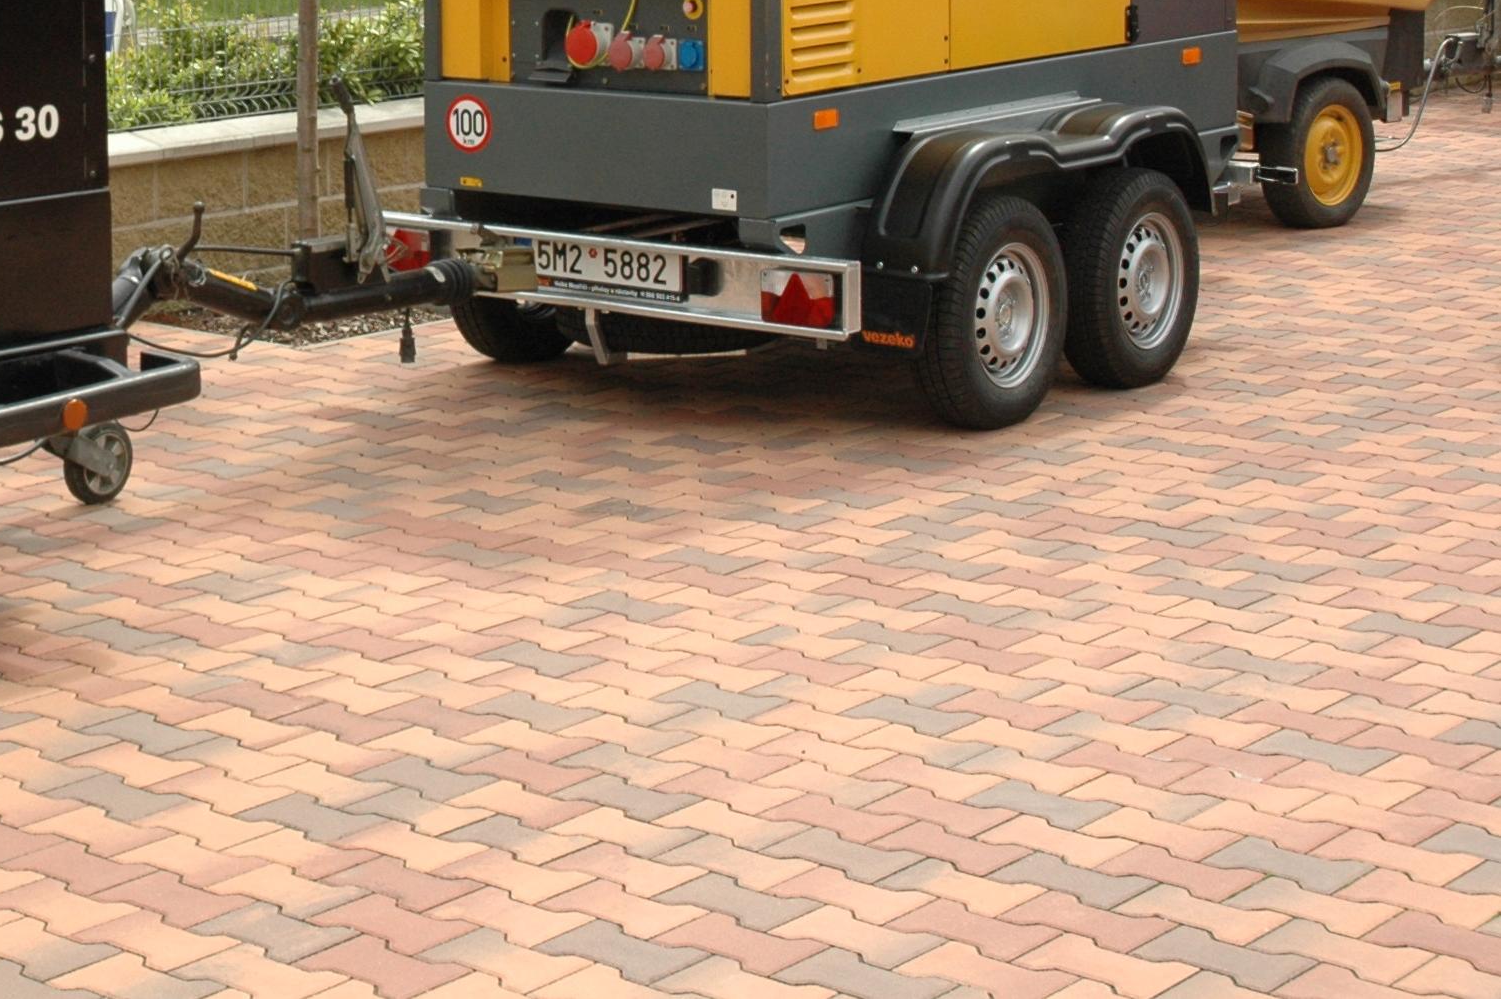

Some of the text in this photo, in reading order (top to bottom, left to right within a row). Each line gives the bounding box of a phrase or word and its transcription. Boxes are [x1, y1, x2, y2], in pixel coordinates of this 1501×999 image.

[15, 104, 59, 141] 30
[453, 107, 485, 137] 100
[538, 240, 667, 285] 5M2 5882
[862, 330, 915, 348] vezeko
